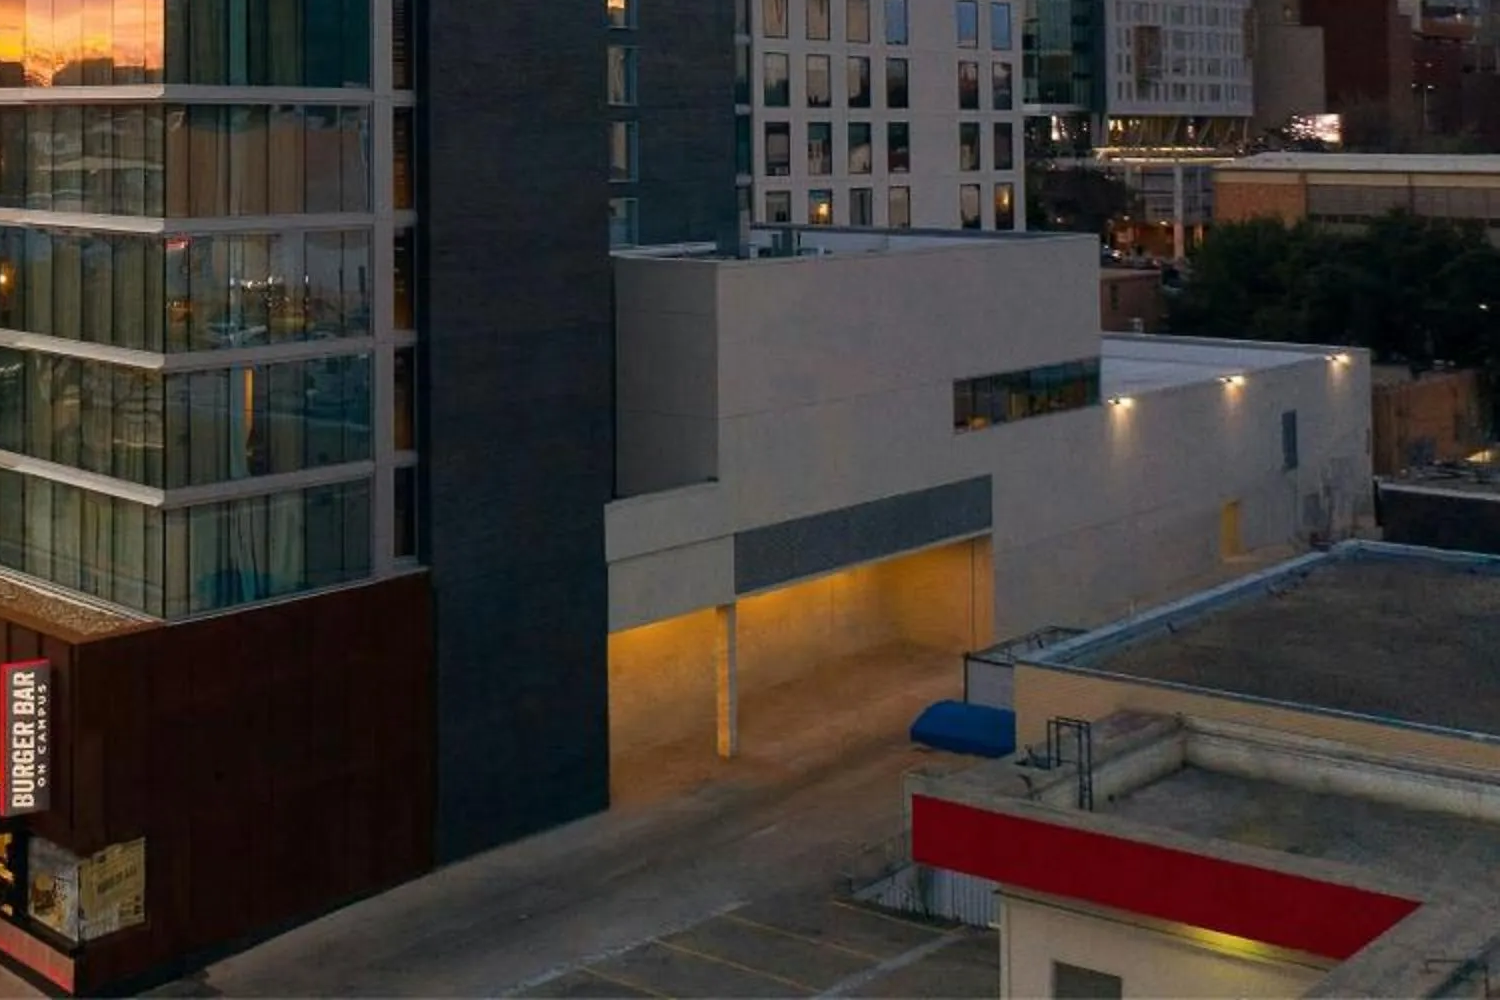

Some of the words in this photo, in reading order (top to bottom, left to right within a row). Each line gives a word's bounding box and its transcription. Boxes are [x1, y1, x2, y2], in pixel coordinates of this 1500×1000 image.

[12, 671, 35, 715] BAR
[37, 683, 47, 755] CAMPUS
[11, 720, 35, 808] BURGER
[37, 764, 47, 788] ON
